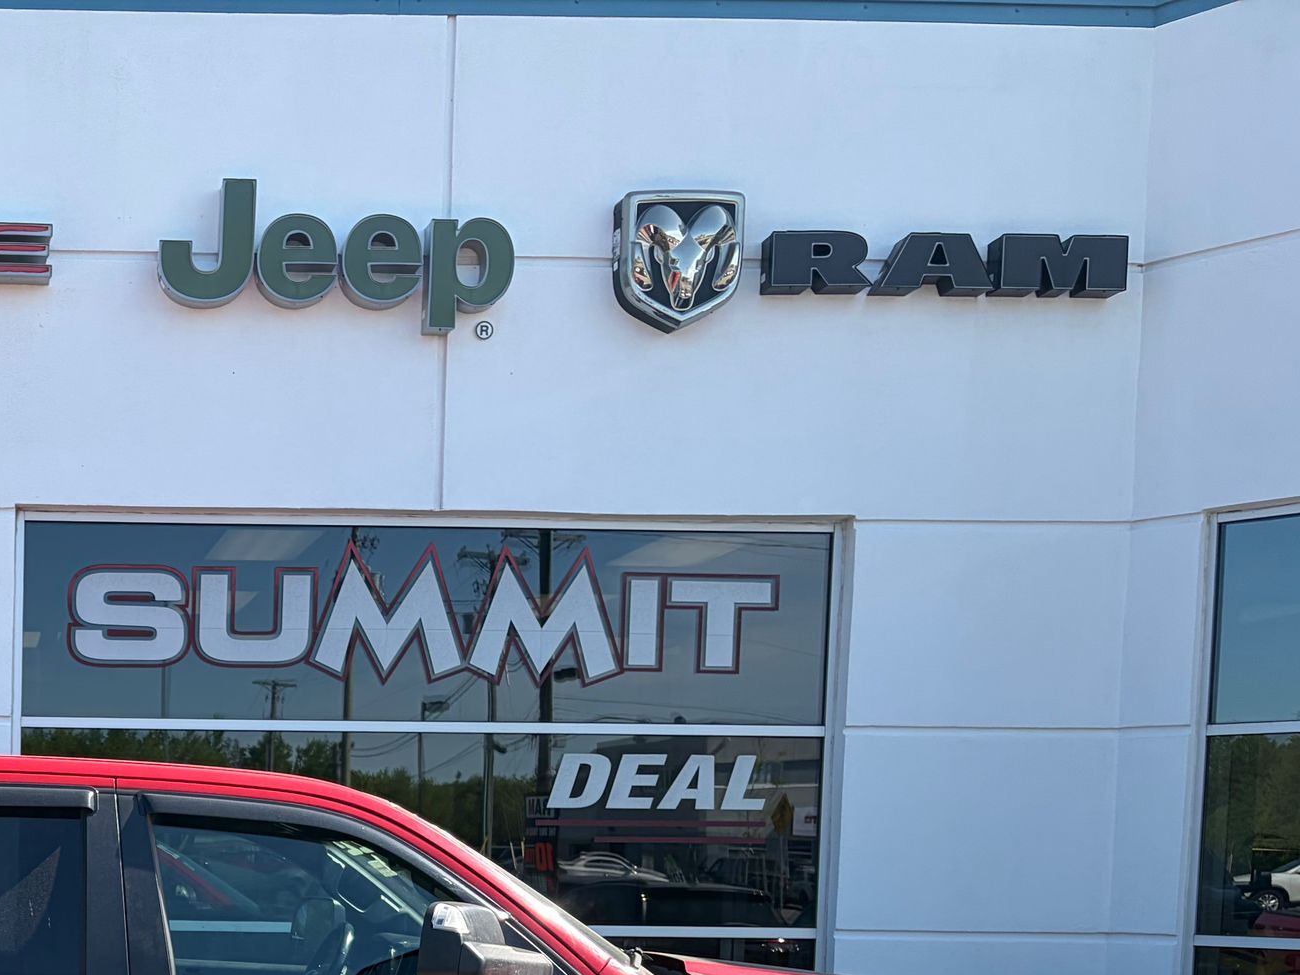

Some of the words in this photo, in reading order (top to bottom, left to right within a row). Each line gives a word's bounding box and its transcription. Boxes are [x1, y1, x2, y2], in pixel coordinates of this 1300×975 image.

[159, 178, 515, 336] Jeep
[760, 229, 1130, 299] RAM
[68, 541, 781, 688] SUMMIT
[546, 753, 768, 812] DEAL
